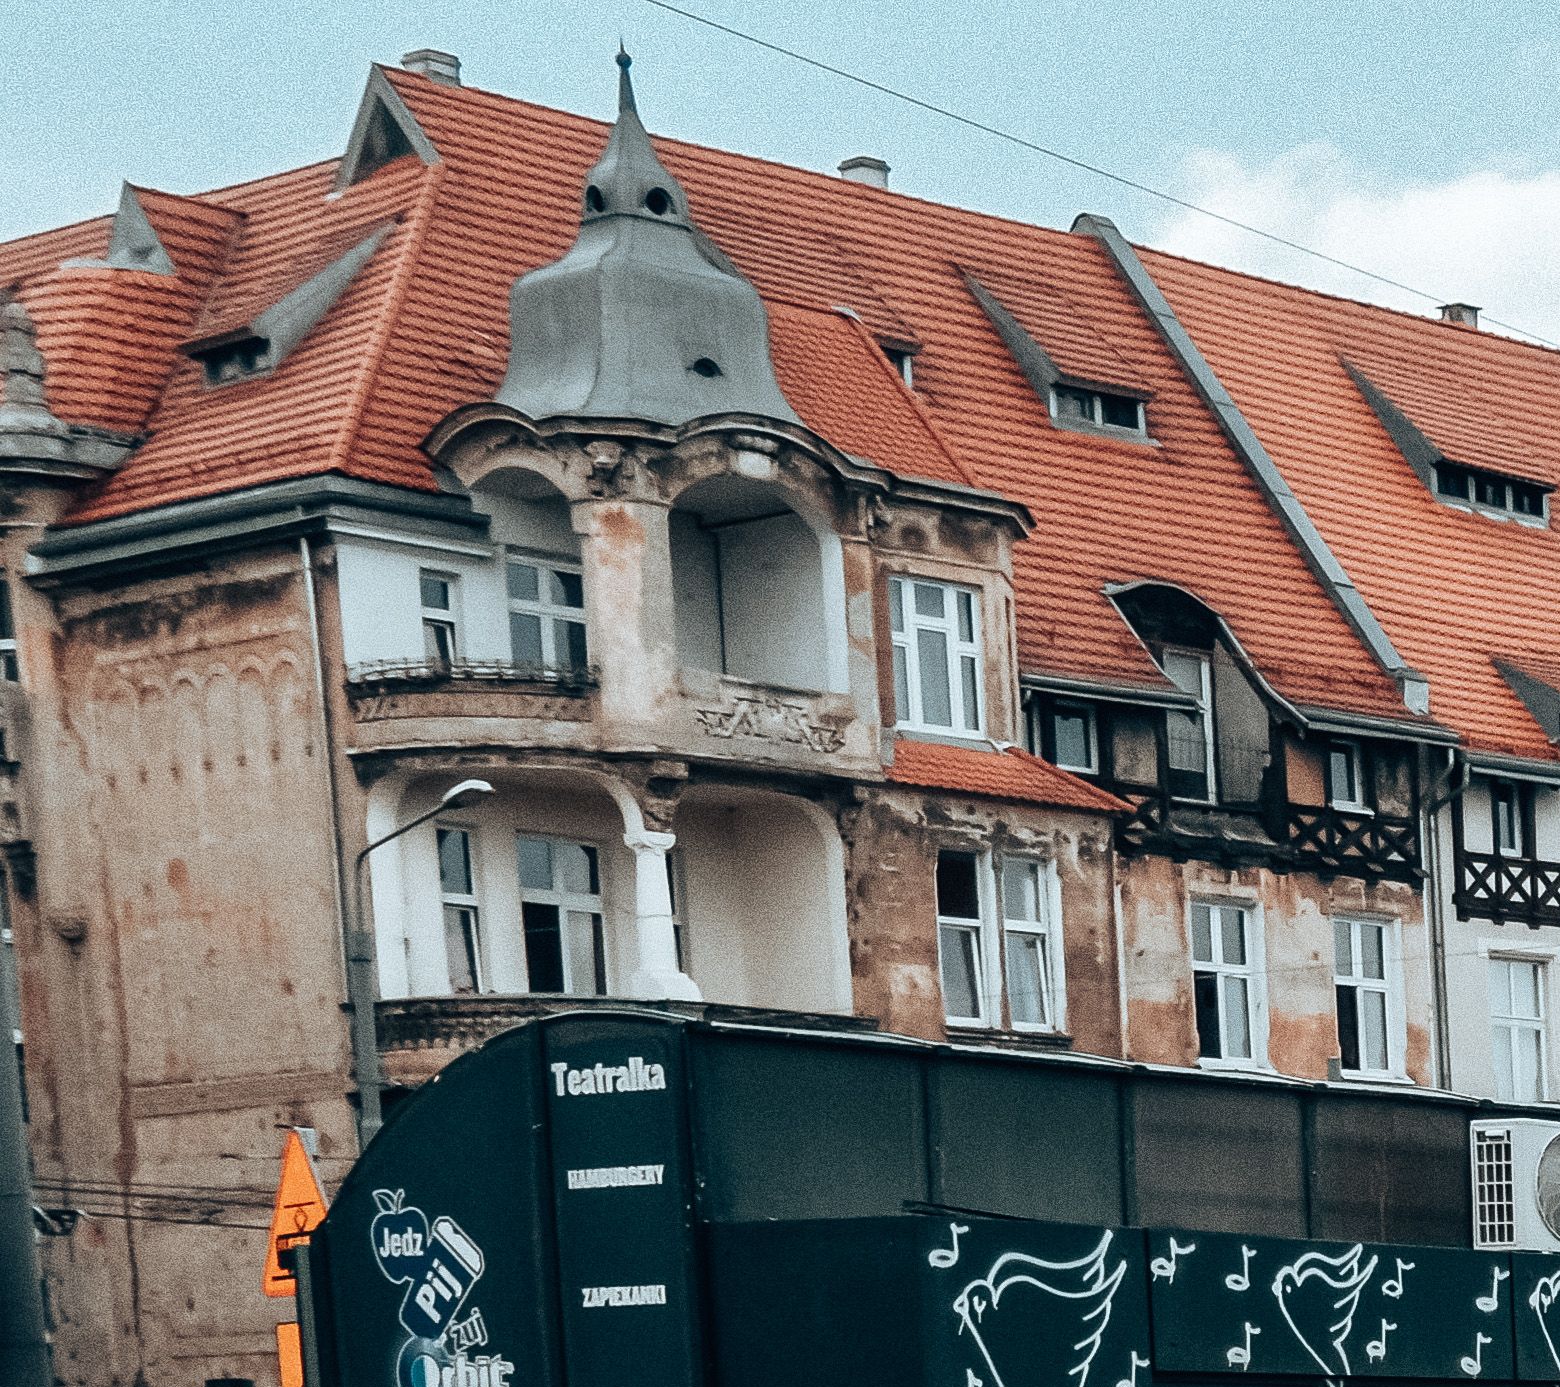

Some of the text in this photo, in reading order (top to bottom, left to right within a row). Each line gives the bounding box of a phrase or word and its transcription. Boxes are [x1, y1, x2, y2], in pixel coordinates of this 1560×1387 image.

[550, 1056, 667, 1096] Teatralka
[567, 1164, 665, 1190] HAMBURGERY
[379, 1226, 425, 1258] Jedz
[414, 1257, 464, 1324] Pij
[581, 1284, 667, 1308] ZAPIEKANKI
